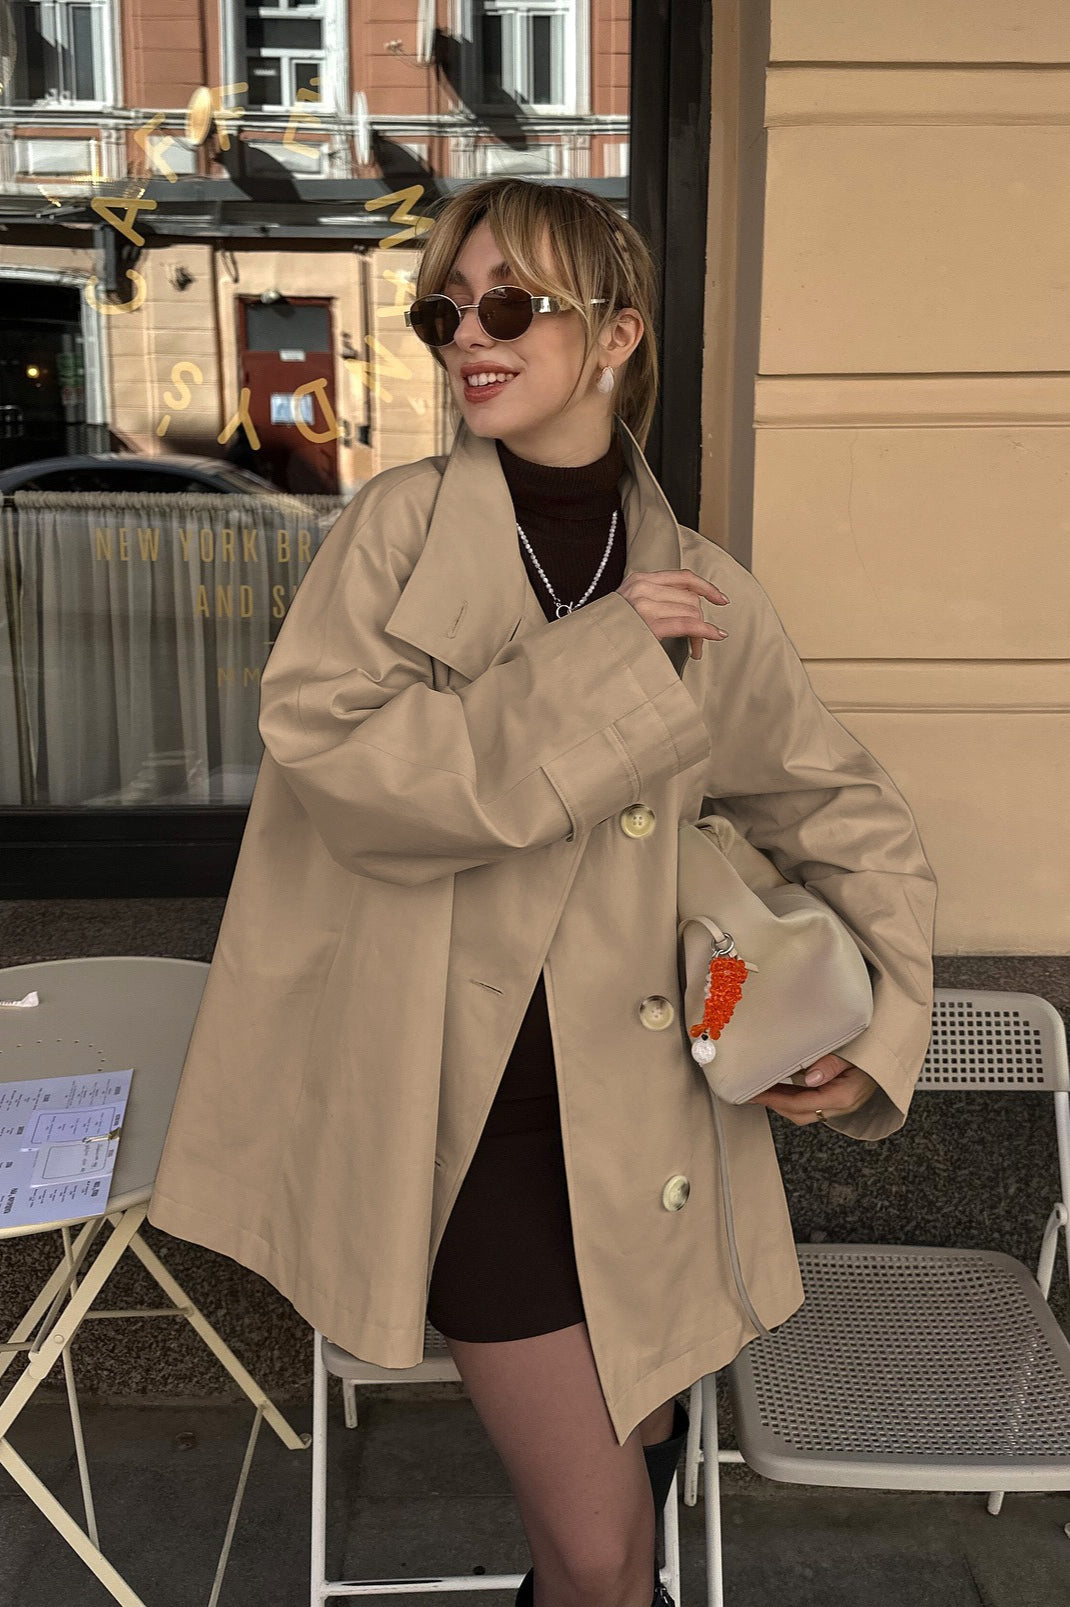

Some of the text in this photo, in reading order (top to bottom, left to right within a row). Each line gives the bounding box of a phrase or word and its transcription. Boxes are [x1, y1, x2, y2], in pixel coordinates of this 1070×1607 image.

[95, 527, 160, 562] NEW
[179, 528, 258, 563] YORK
[196, 585, 254, 618] AND
